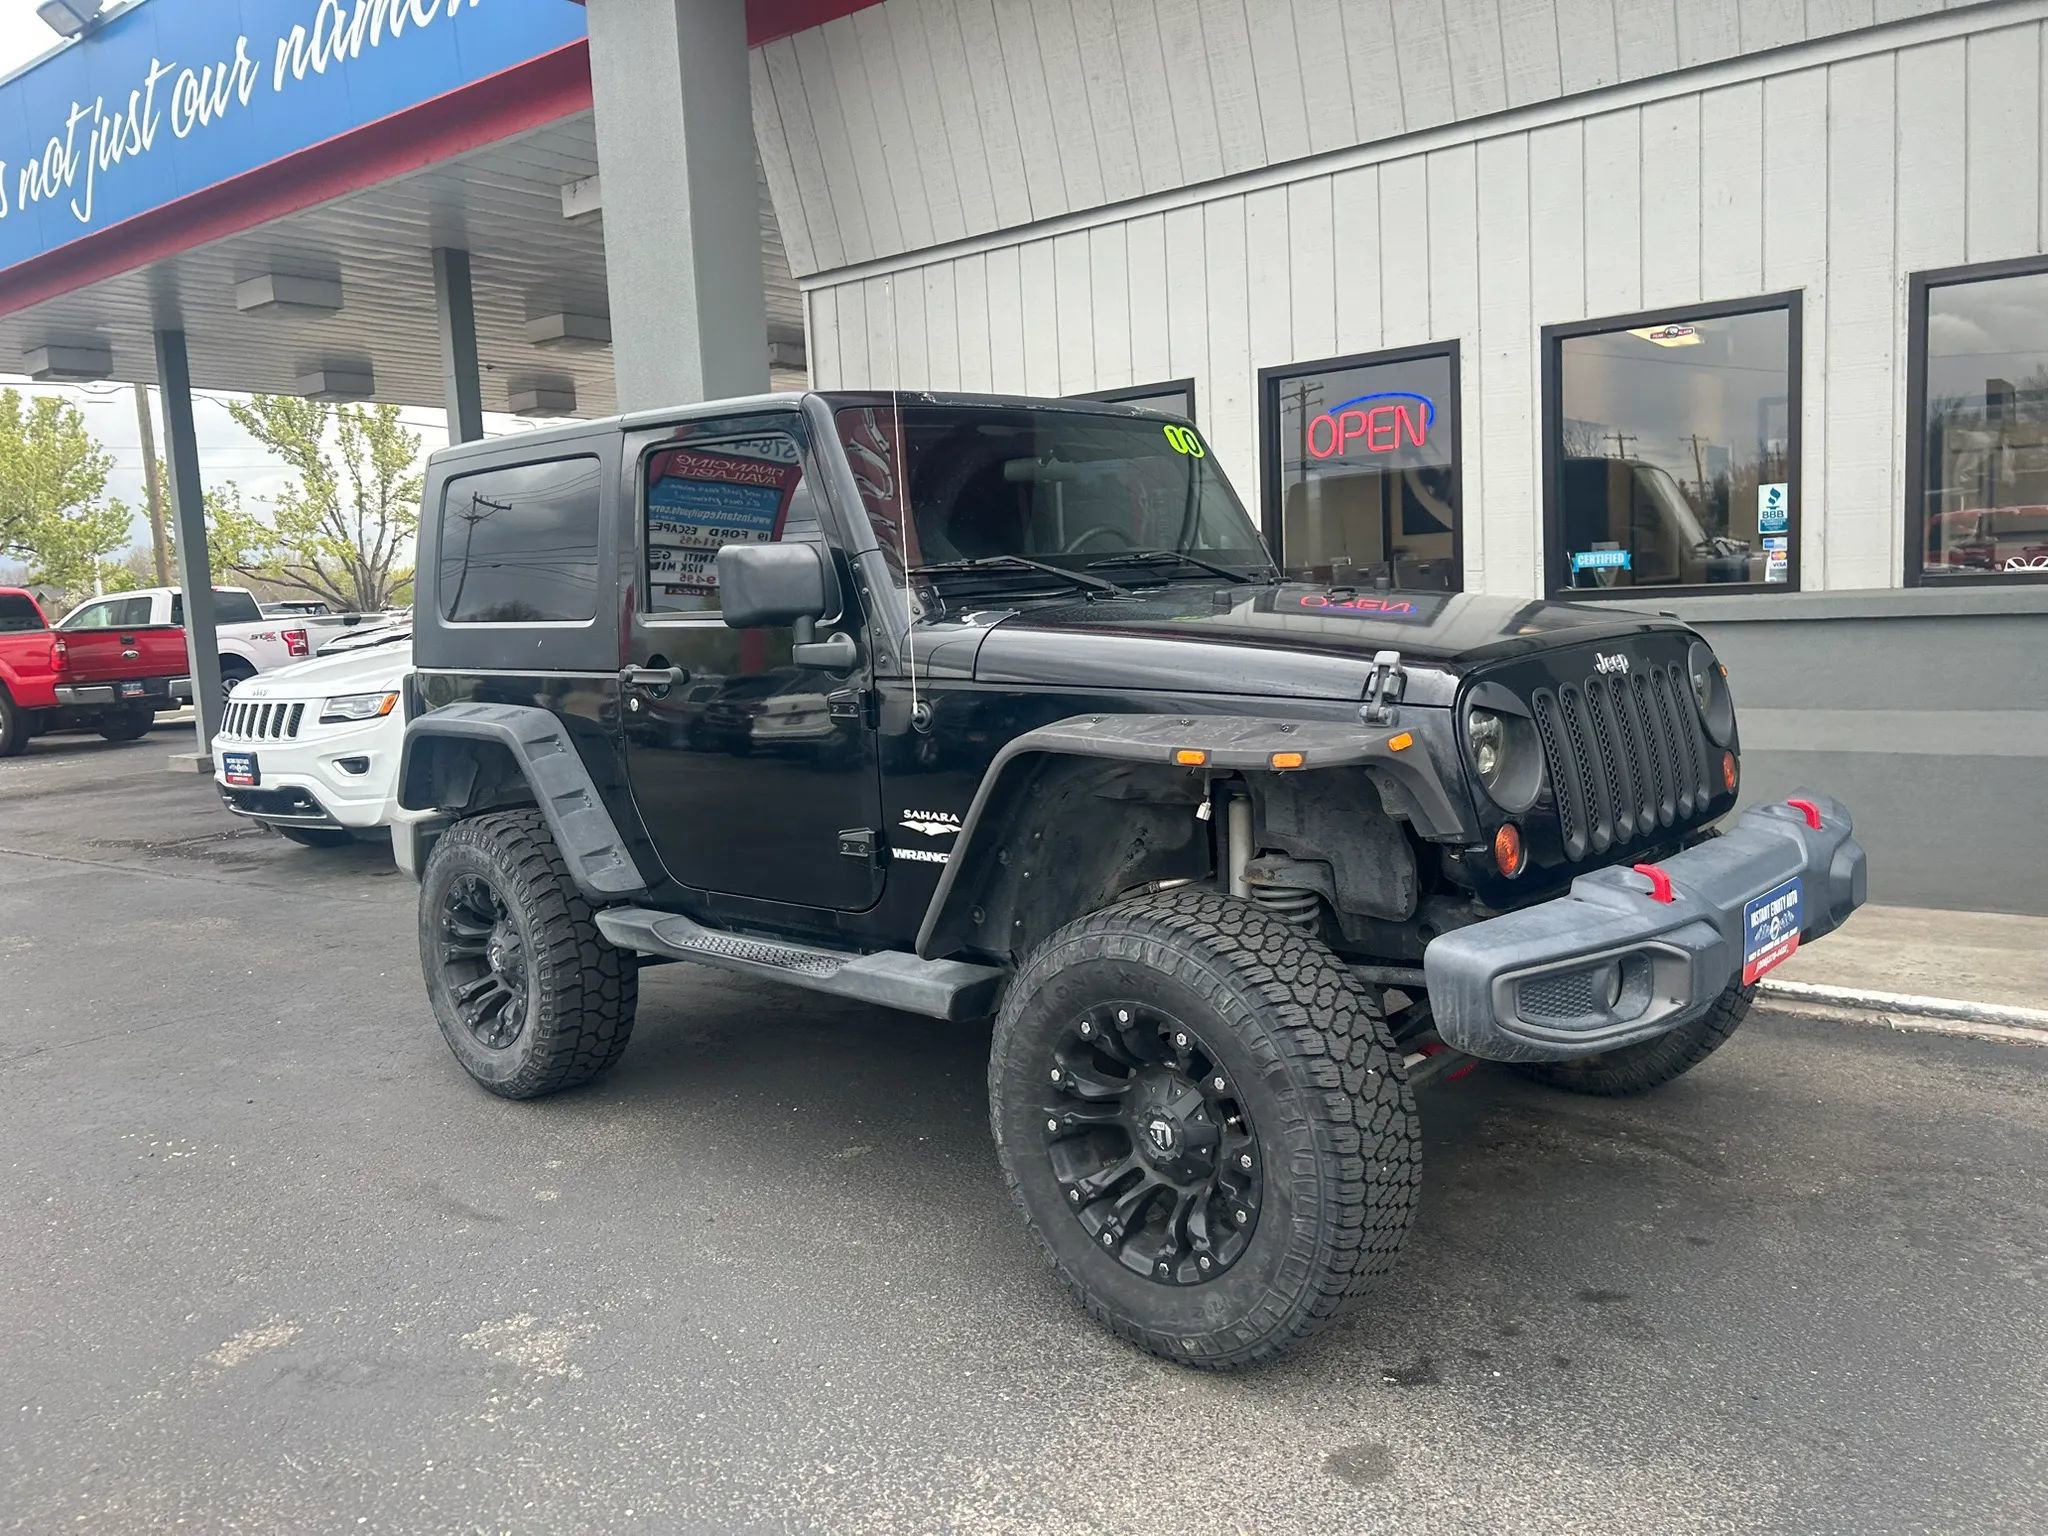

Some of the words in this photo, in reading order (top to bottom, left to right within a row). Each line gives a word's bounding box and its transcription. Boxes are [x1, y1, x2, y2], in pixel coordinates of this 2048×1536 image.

[19, 101, 93, 210] not
[71, 58, 176, 223] just
[171, 35, 259, 138] our
[1308, 403, 1425, 458] OPEN
[1163, 425, 1205, 458] 10
[1762, 510, 1785, 519] BBB
[1577, 552, 1625, 566] CERTIFIED
[1594, 652, 1630, 675] Jeep
[903, 809, 960, 823] SAHARA
[892, 847, 951, 864] WRANG
